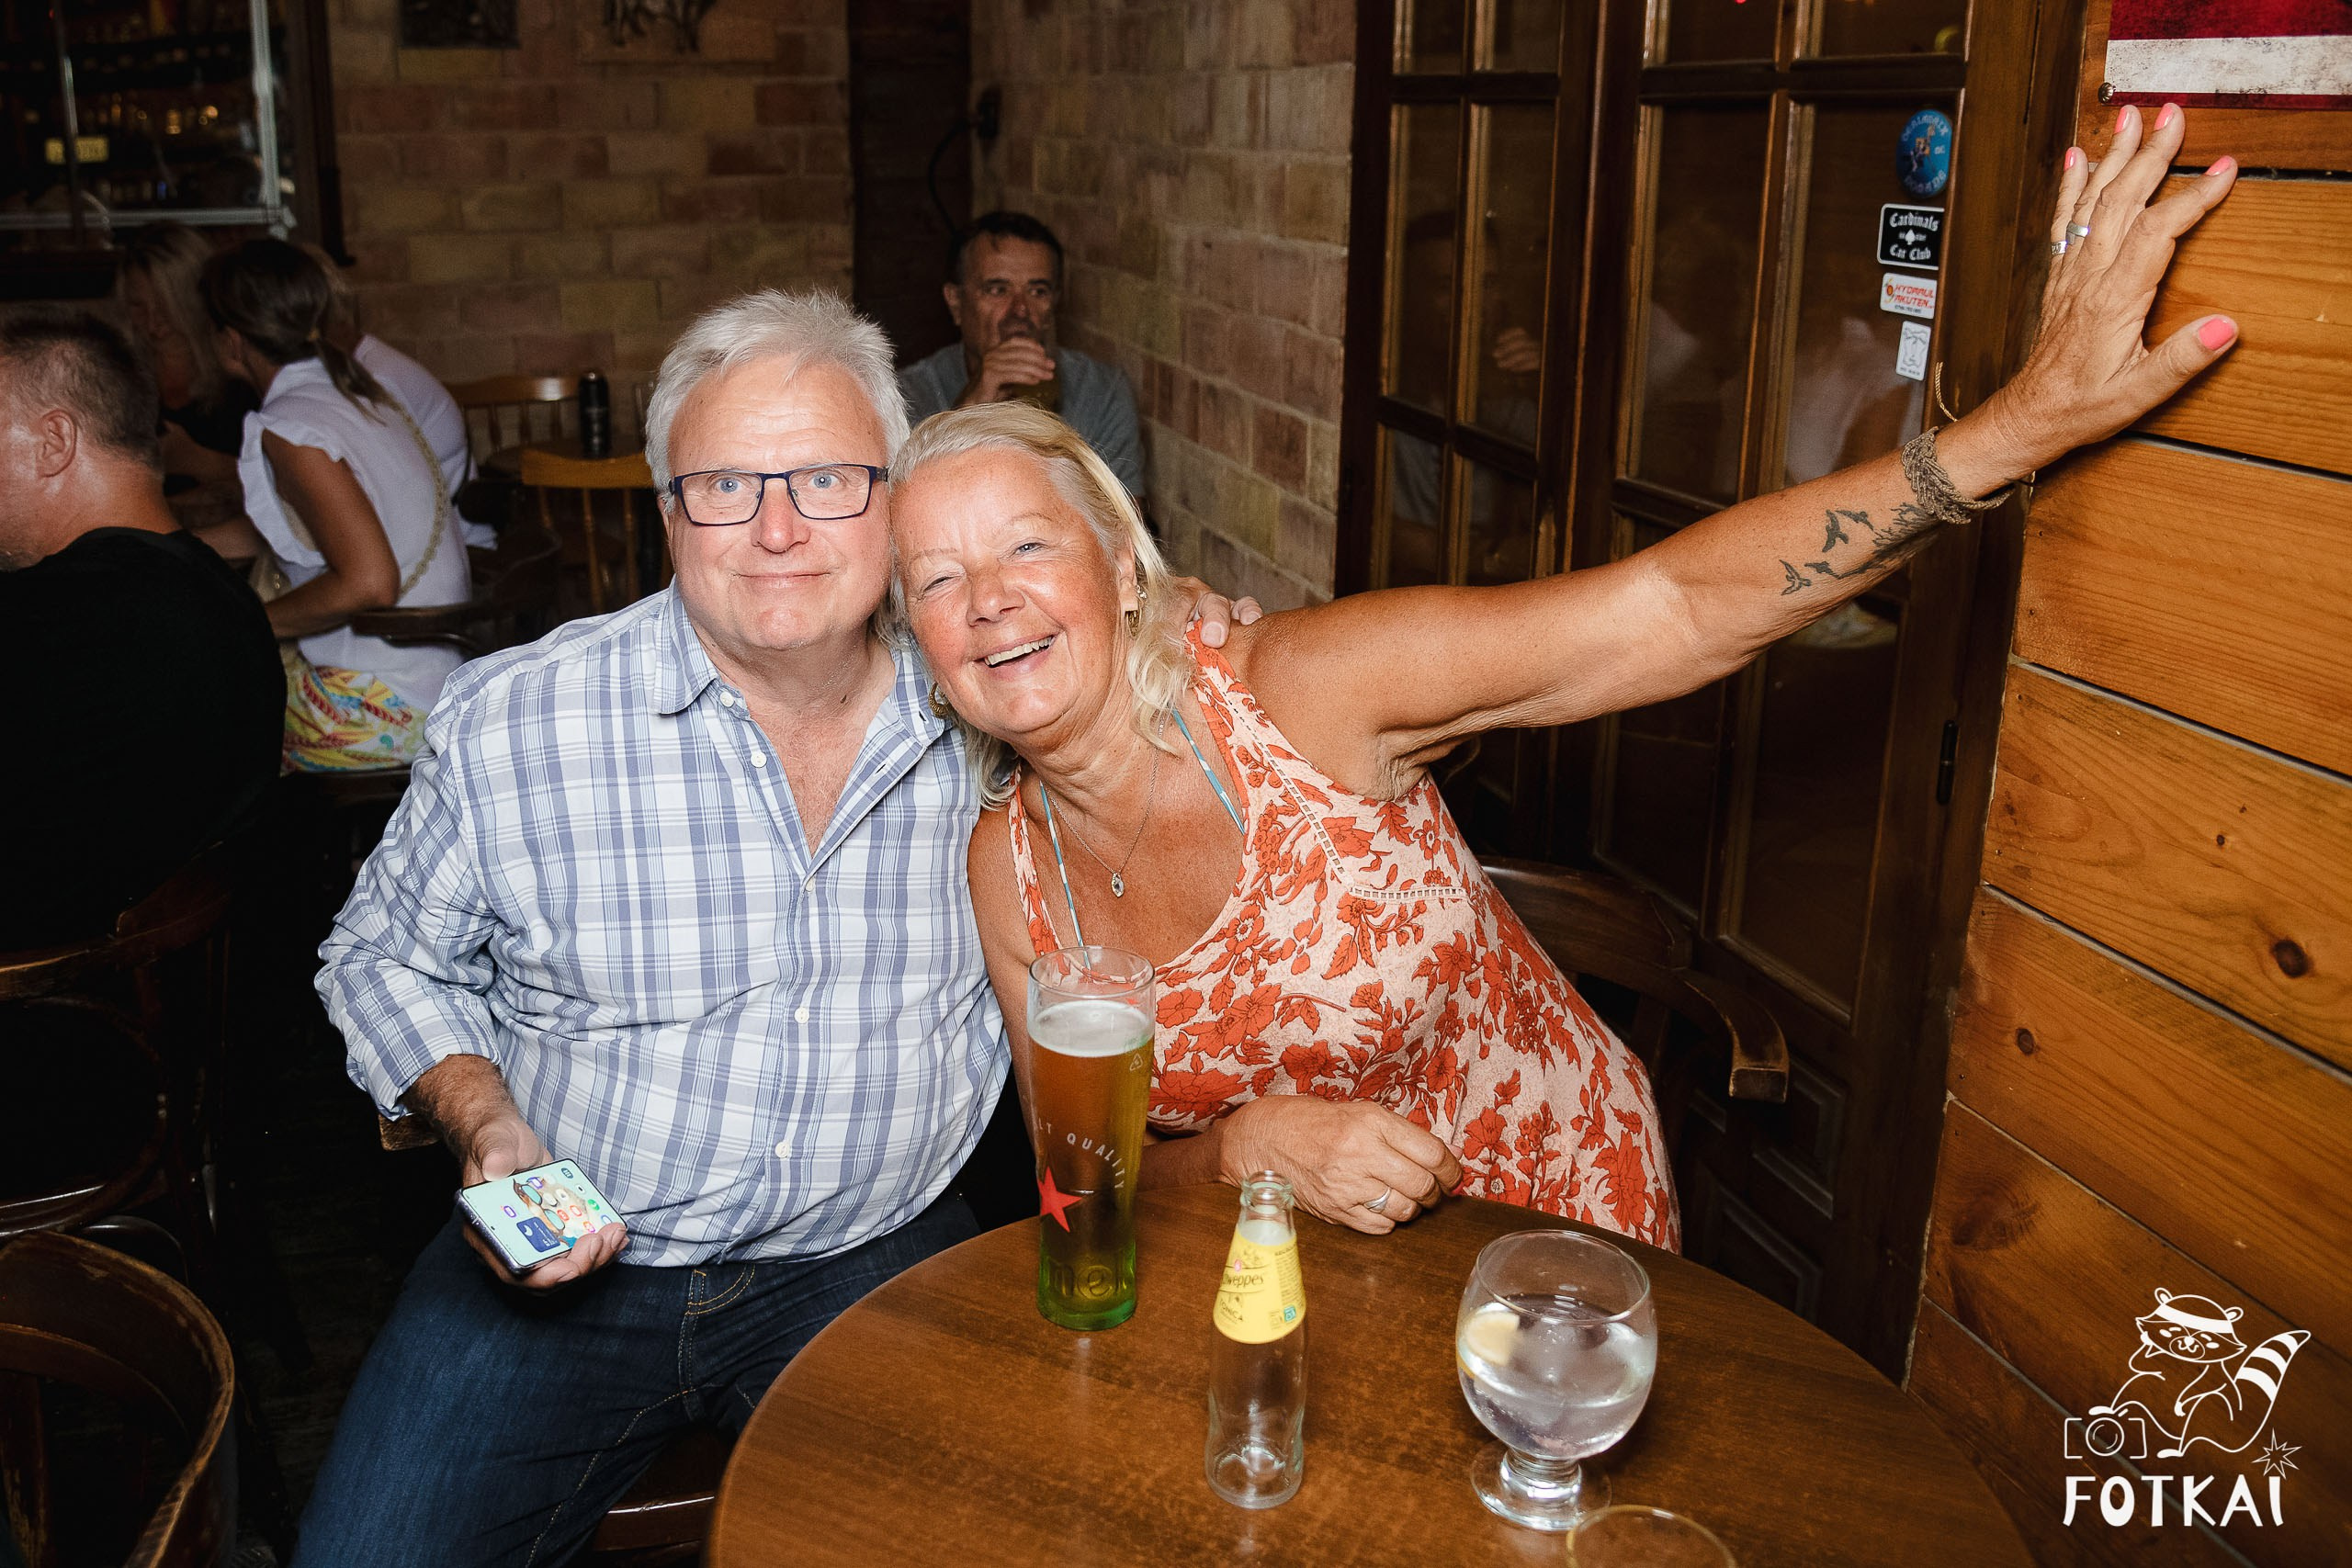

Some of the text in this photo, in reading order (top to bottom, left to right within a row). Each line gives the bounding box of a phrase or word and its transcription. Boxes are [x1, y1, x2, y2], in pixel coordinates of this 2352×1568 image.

[1889, 212, 1939, 231] Cardinals
[1889, 243, 1931, 261] Car Club
[1067, 1133, 1125, 1189] QUALITY
